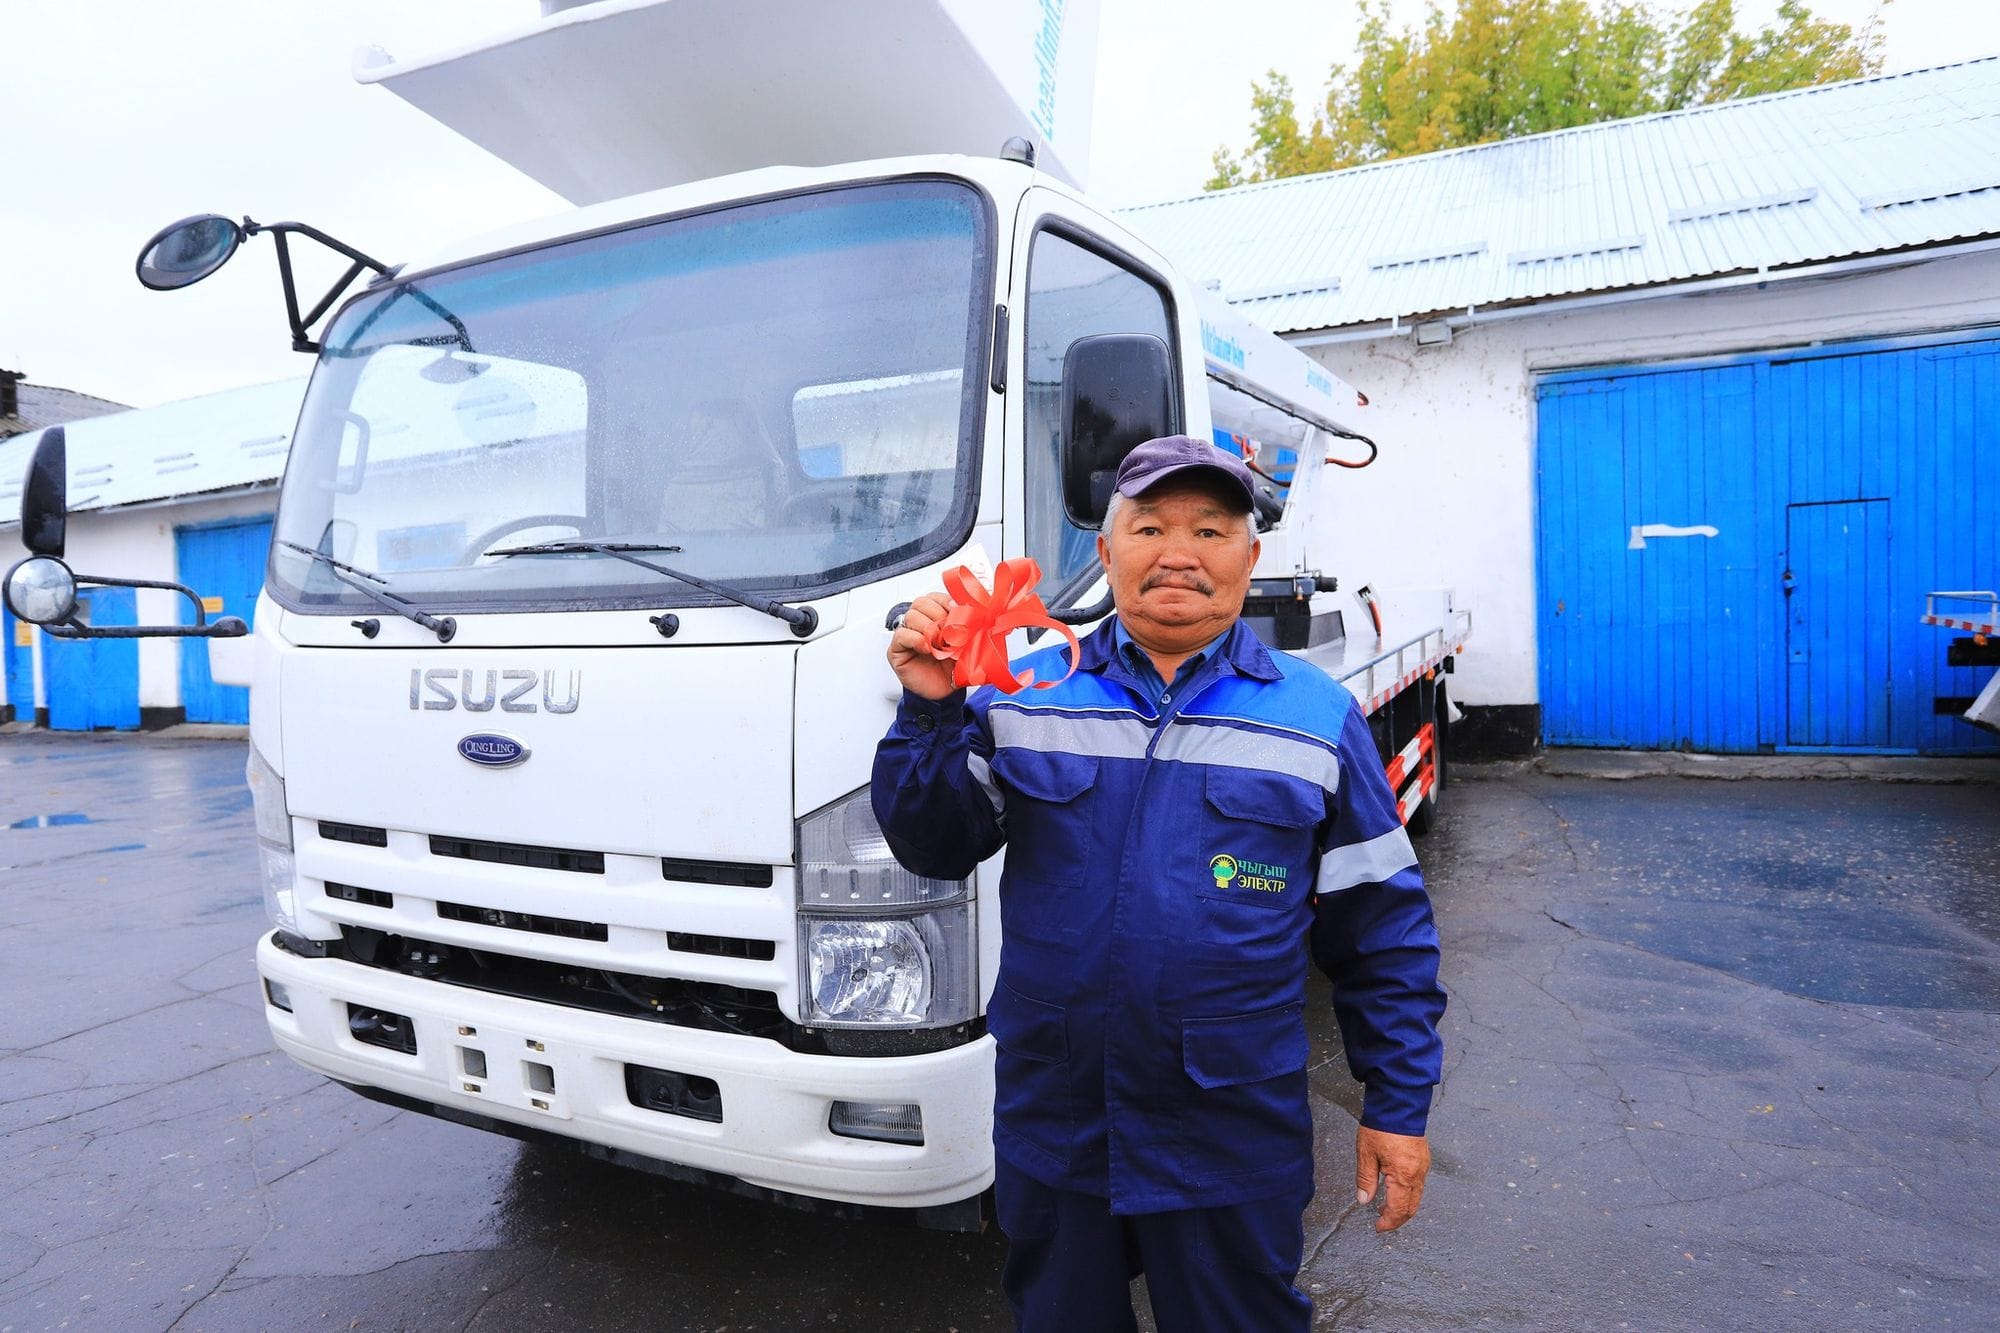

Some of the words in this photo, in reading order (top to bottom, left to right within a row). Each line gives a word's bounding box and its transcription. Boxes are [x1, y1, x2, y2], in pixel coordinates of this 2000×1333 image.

[409, 668, 582, 714] ISUZU
[465, 739, 515, 755] QINGLING
[1237, 859, 1287, 879] ЧЫГЫШ
[1237, 874, 1286, 893] ЭЛЕКТР
